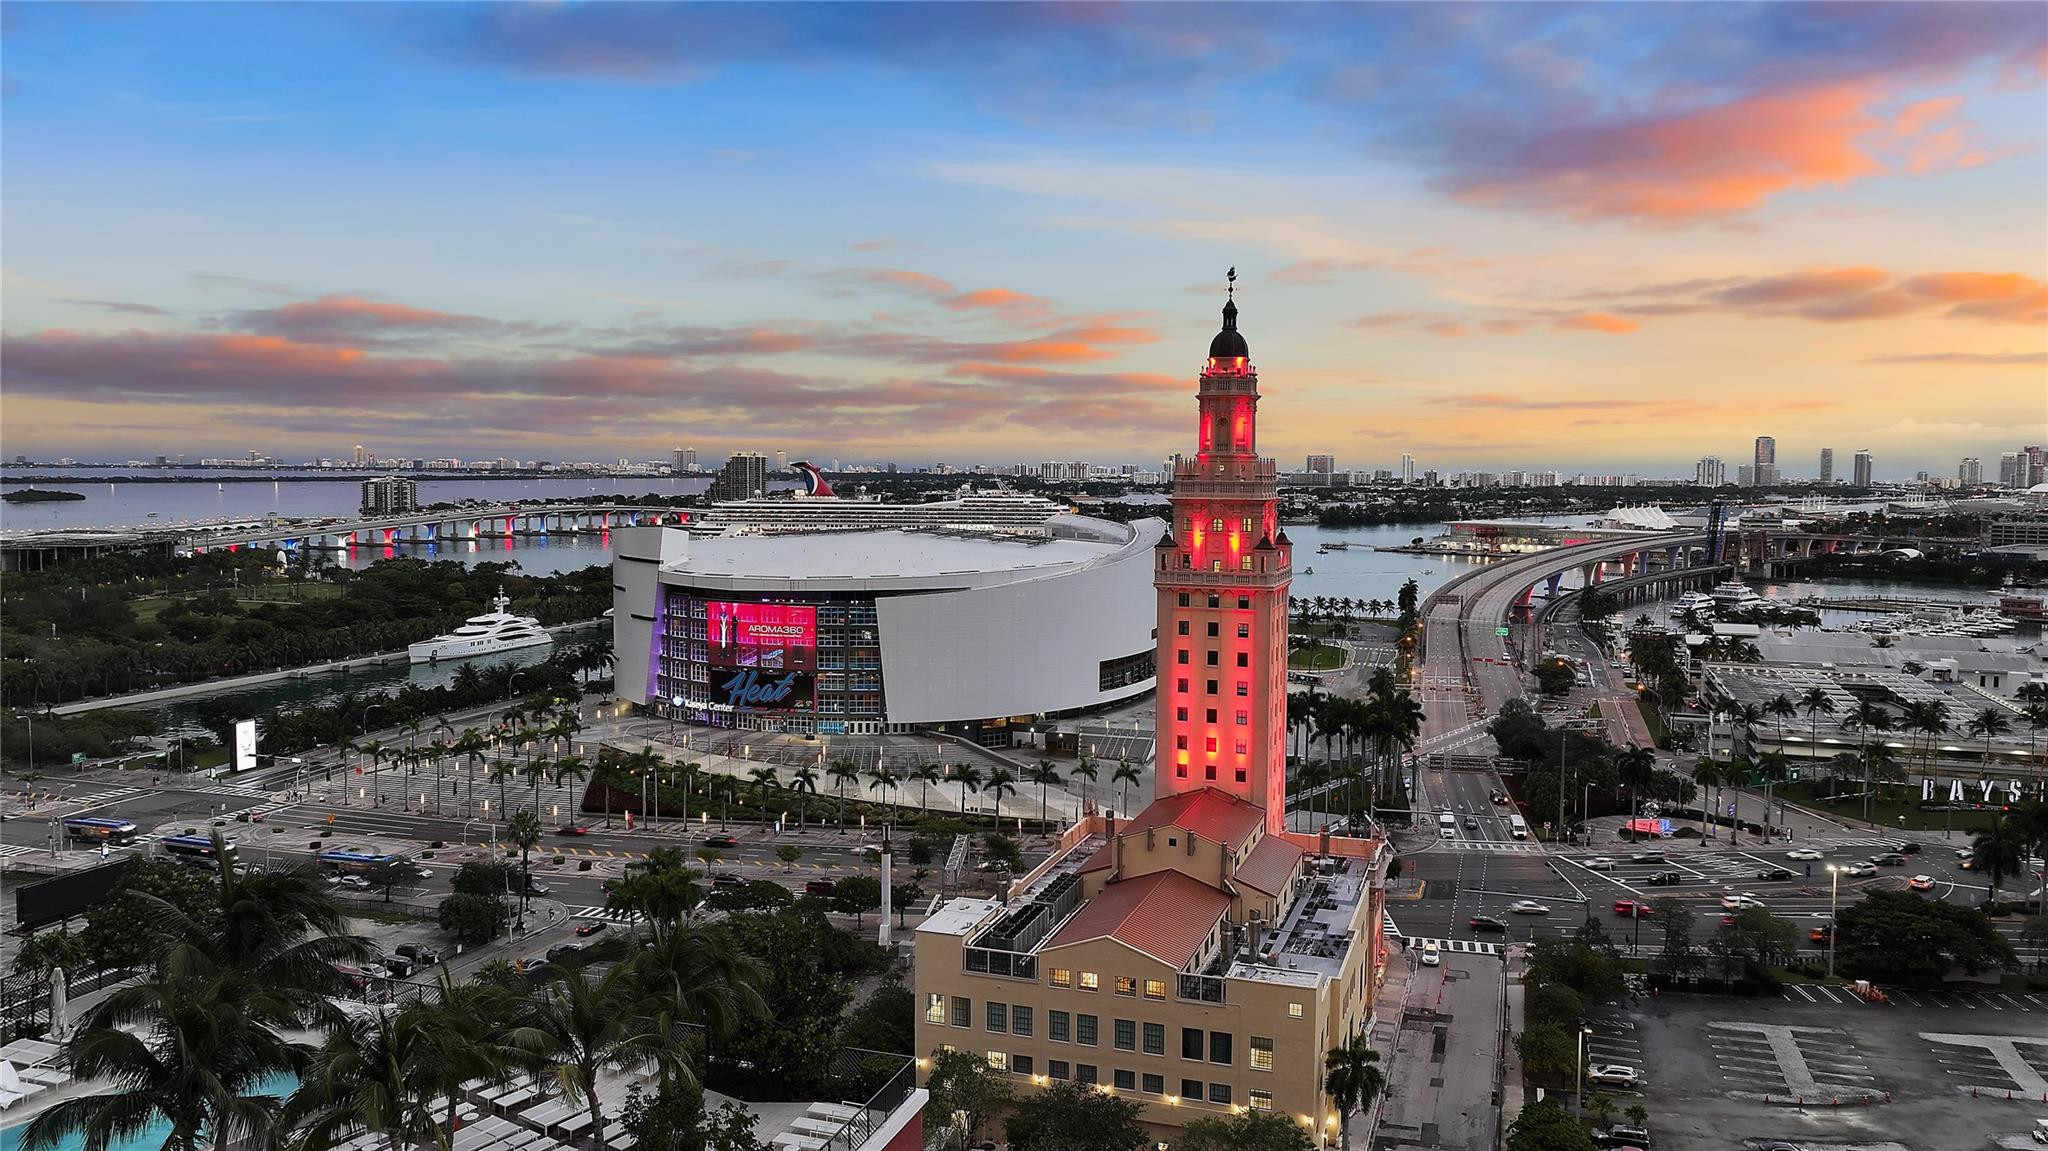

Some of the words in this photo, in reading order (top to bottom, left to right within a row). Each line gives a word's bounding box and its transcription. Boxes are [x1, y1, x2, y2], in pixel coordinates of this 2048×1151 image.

[748, 625, 804, 634] AROMA360
[721, 670, 796, 706] Heat
[684, 699, 708, 711] Kaseya
[708, 701, 735, 712] Center
